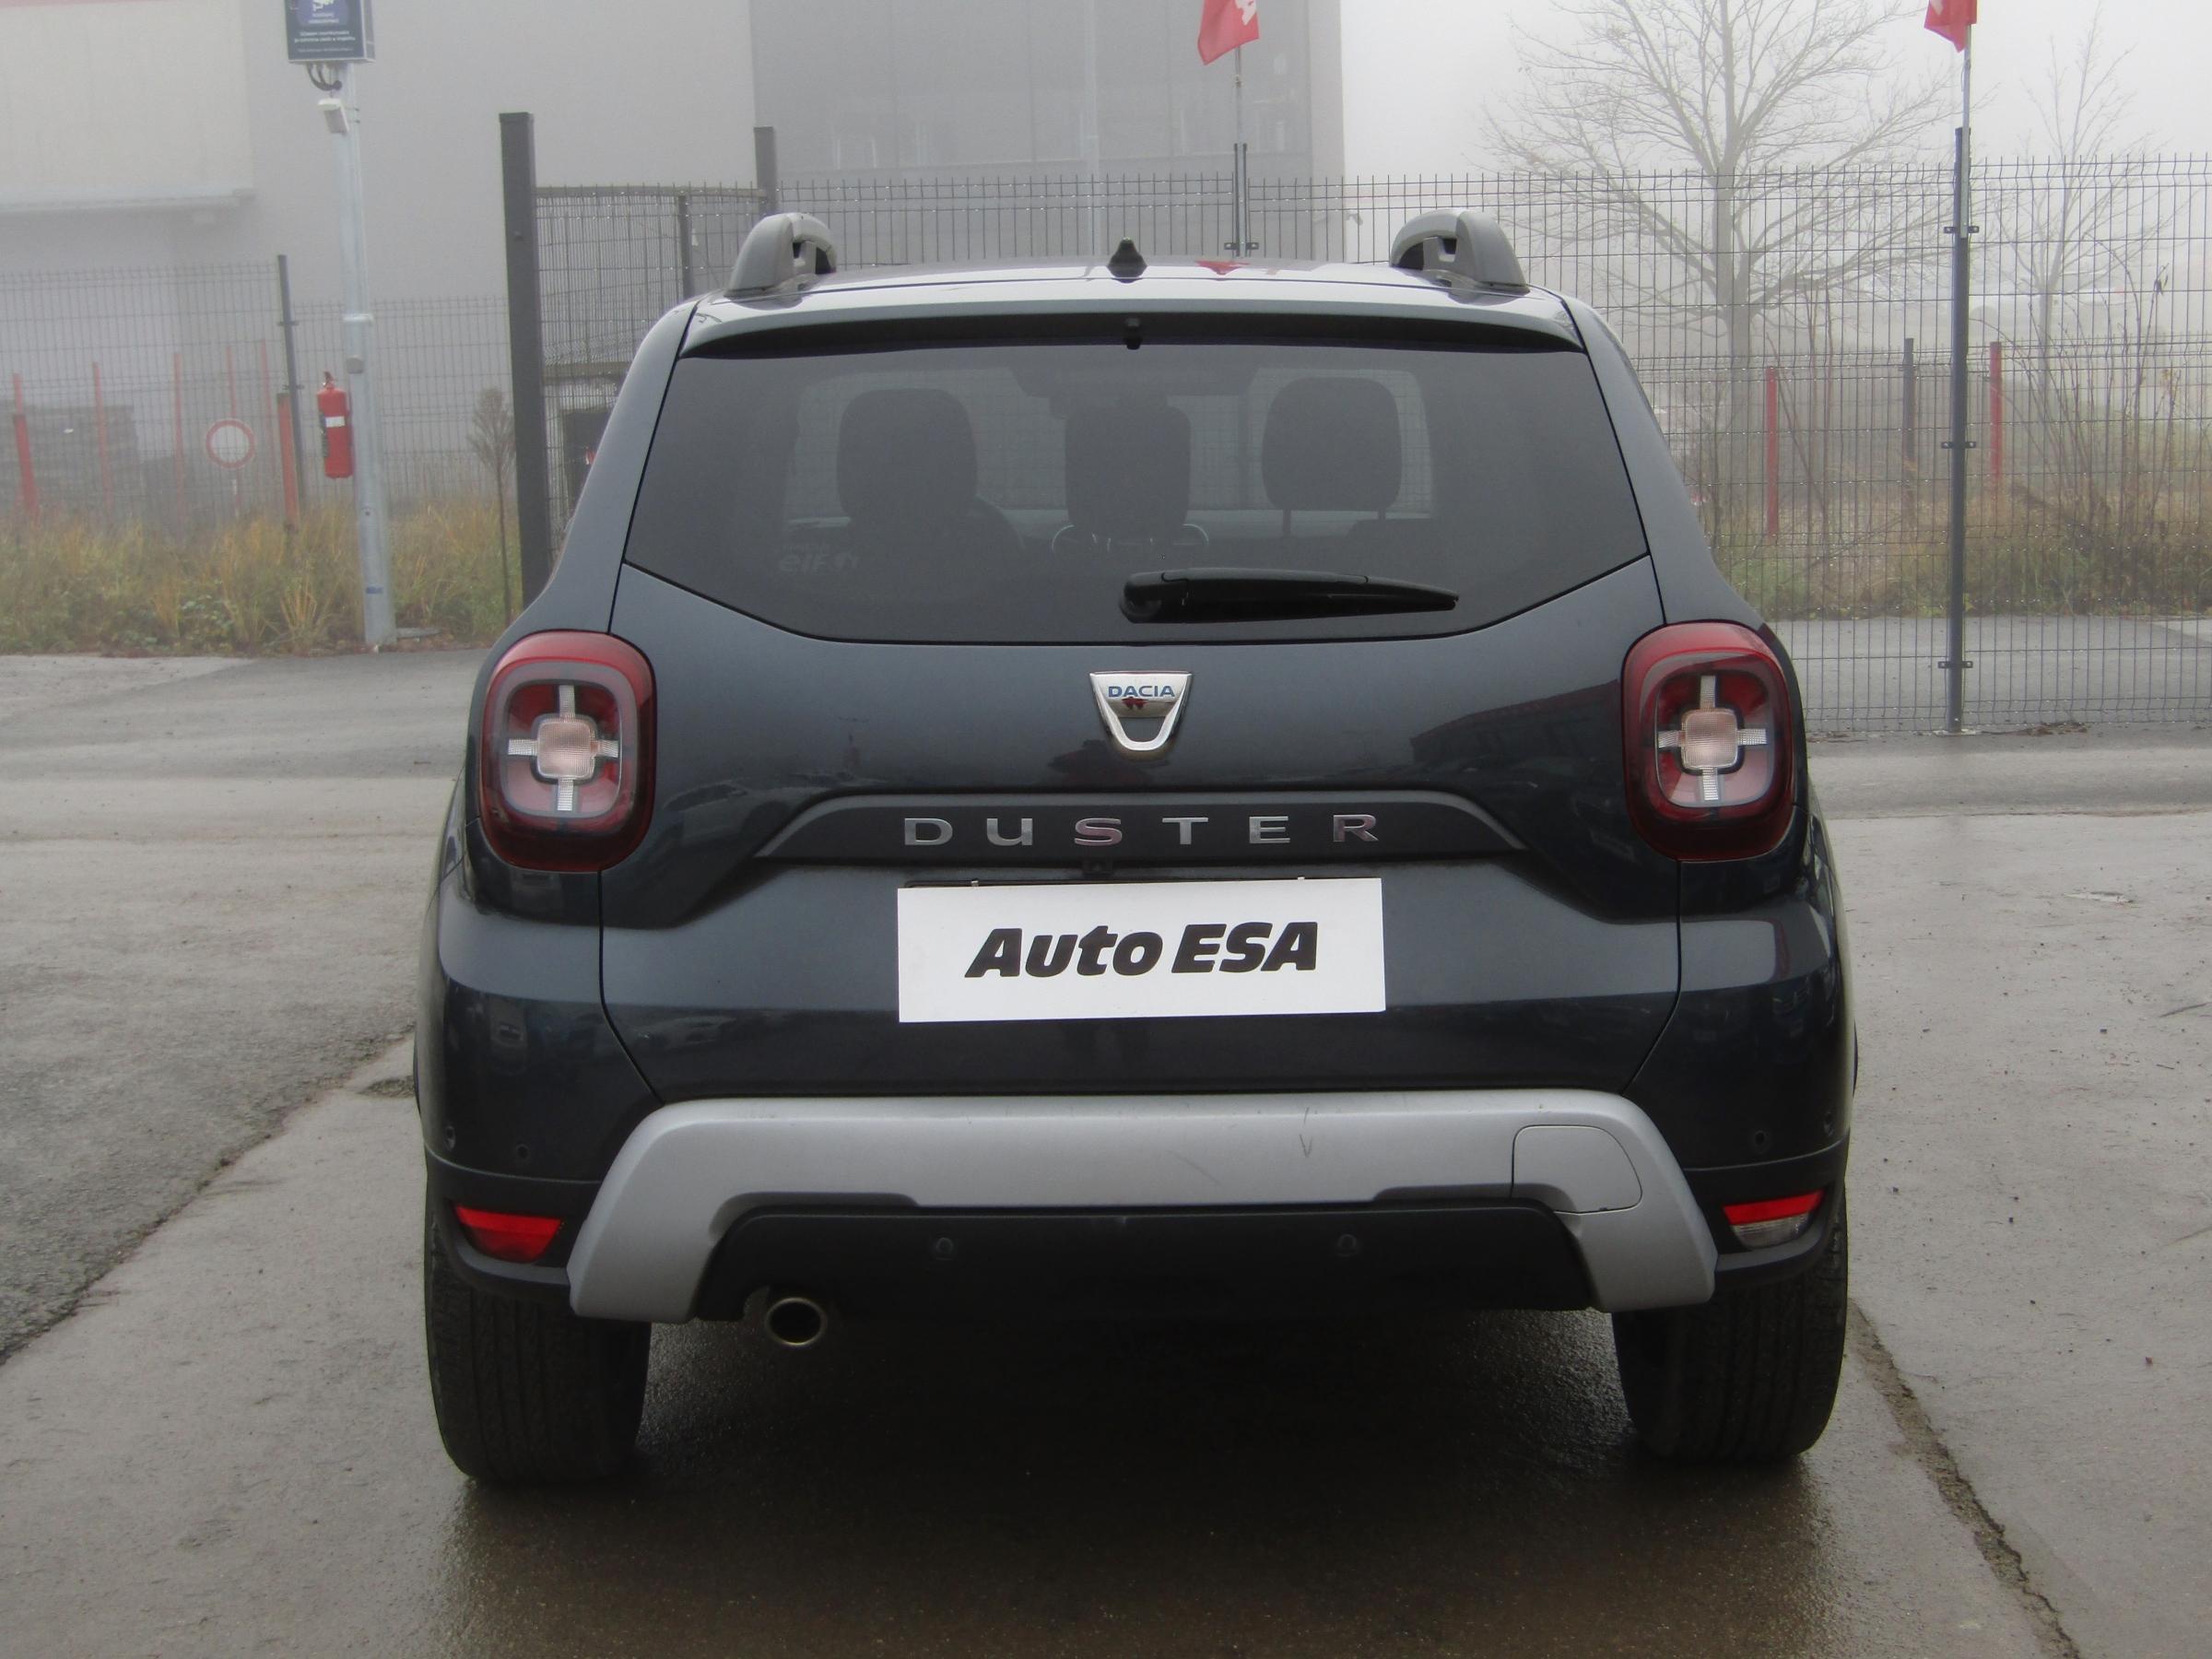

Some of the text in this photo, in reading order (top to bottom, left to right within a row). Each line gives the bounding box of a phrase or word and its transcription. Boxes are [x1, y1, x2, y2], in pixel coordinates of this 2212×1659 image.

[1108, 685, 1175, 698] DACIA
[903, 814, 1380, 846] DUSTER
[964, 922, 1318, 978] Auto ESA
